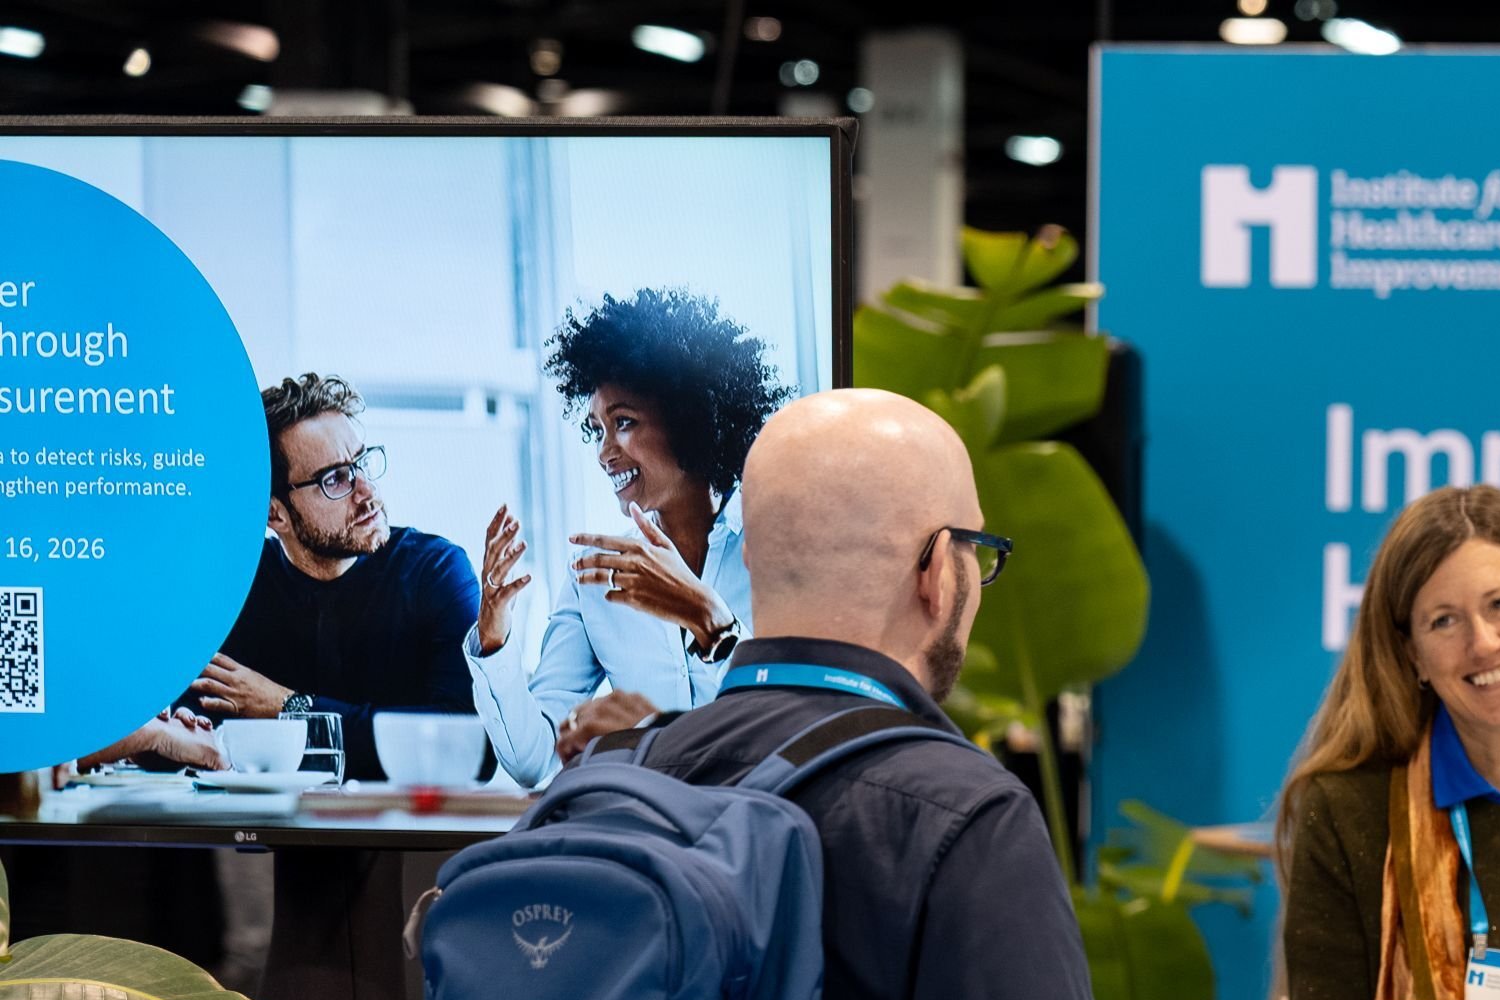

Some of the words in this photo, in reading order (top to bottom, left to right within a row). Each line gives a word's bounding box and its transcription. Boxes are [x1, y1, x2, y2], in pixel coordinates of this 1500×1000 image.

[10, 448, 30, 466] to
[35, 446, 95, 467] detect
[100, 447, 147, 470] risks,
[153, 448, 205, 471] guide
[65, 476, 192, 499] performance.
[6, 537, 39, 562] 16,
[48, 537, 105, 559] 2026
[245, 832, 257, 841] LG
[512, 903, 574, 927] OSPREY
